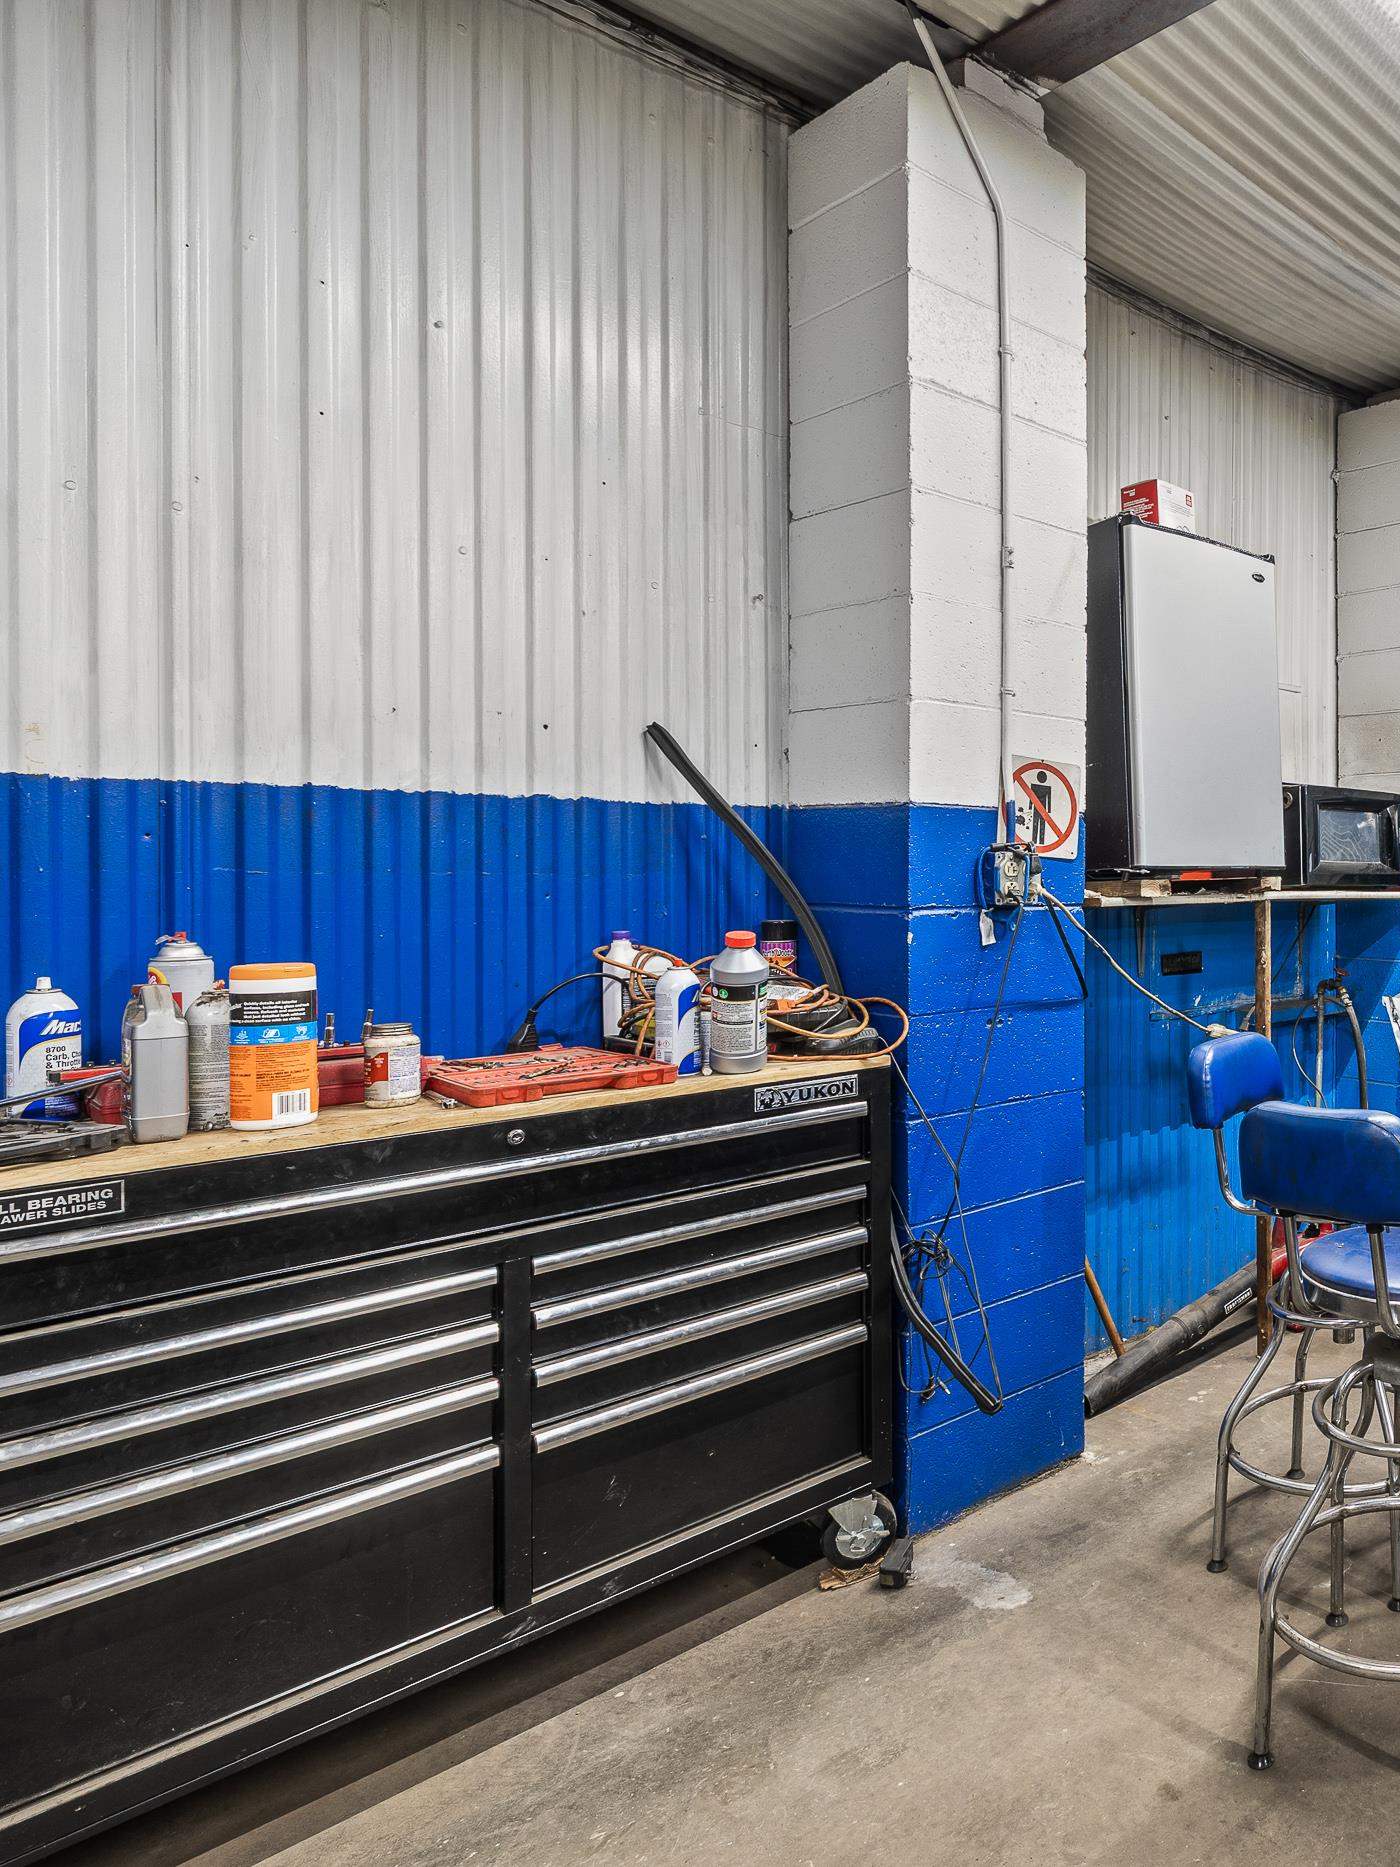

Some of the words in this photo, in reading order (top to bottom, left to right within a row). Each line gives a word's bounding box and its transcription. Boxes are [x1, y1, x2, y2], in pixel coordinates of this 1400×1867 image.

[45, 1045, 66, 1053] 8700
[45, 1052, 70, 1061] Carb,
[783, 1081, 855, 1103] YUKON
[27, 1189, 114, 1211] BEARING
[51, 1200, 107, 1217] SLIDES
